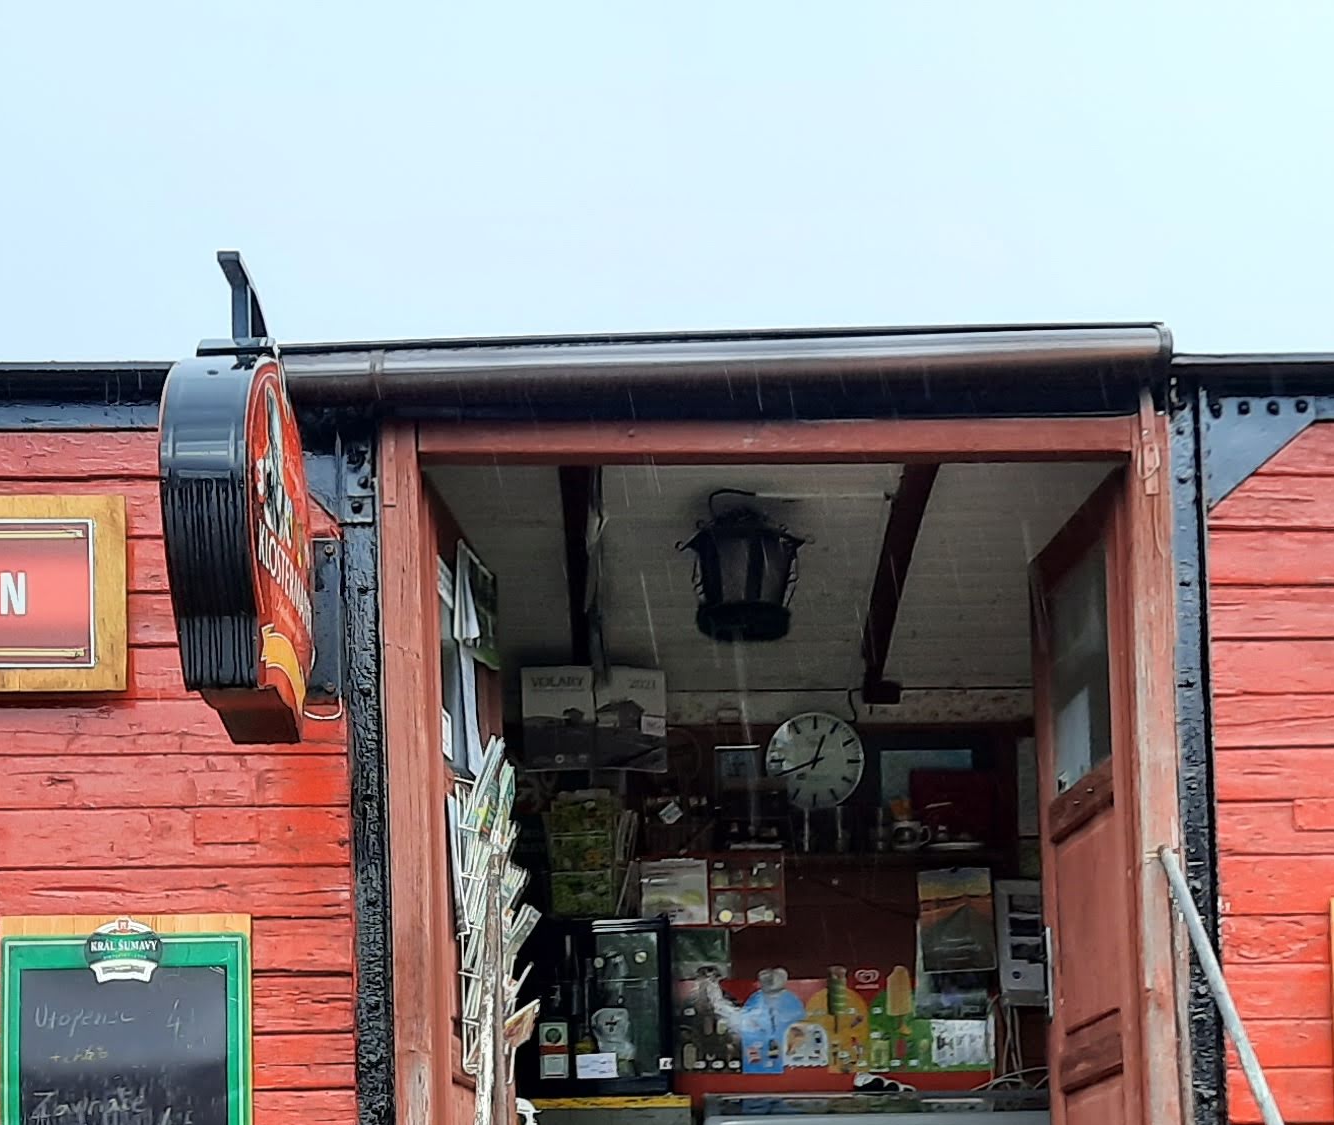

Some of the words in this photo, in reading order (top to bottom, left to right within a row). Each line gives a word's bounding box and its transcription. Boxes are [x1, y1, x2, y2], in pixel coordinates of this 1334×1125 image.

[530, 675, 585, 688] VOLARY
[90, 939, 116, 952] KRÁL
[117, 938, 158, 951] ŠUMAVY
